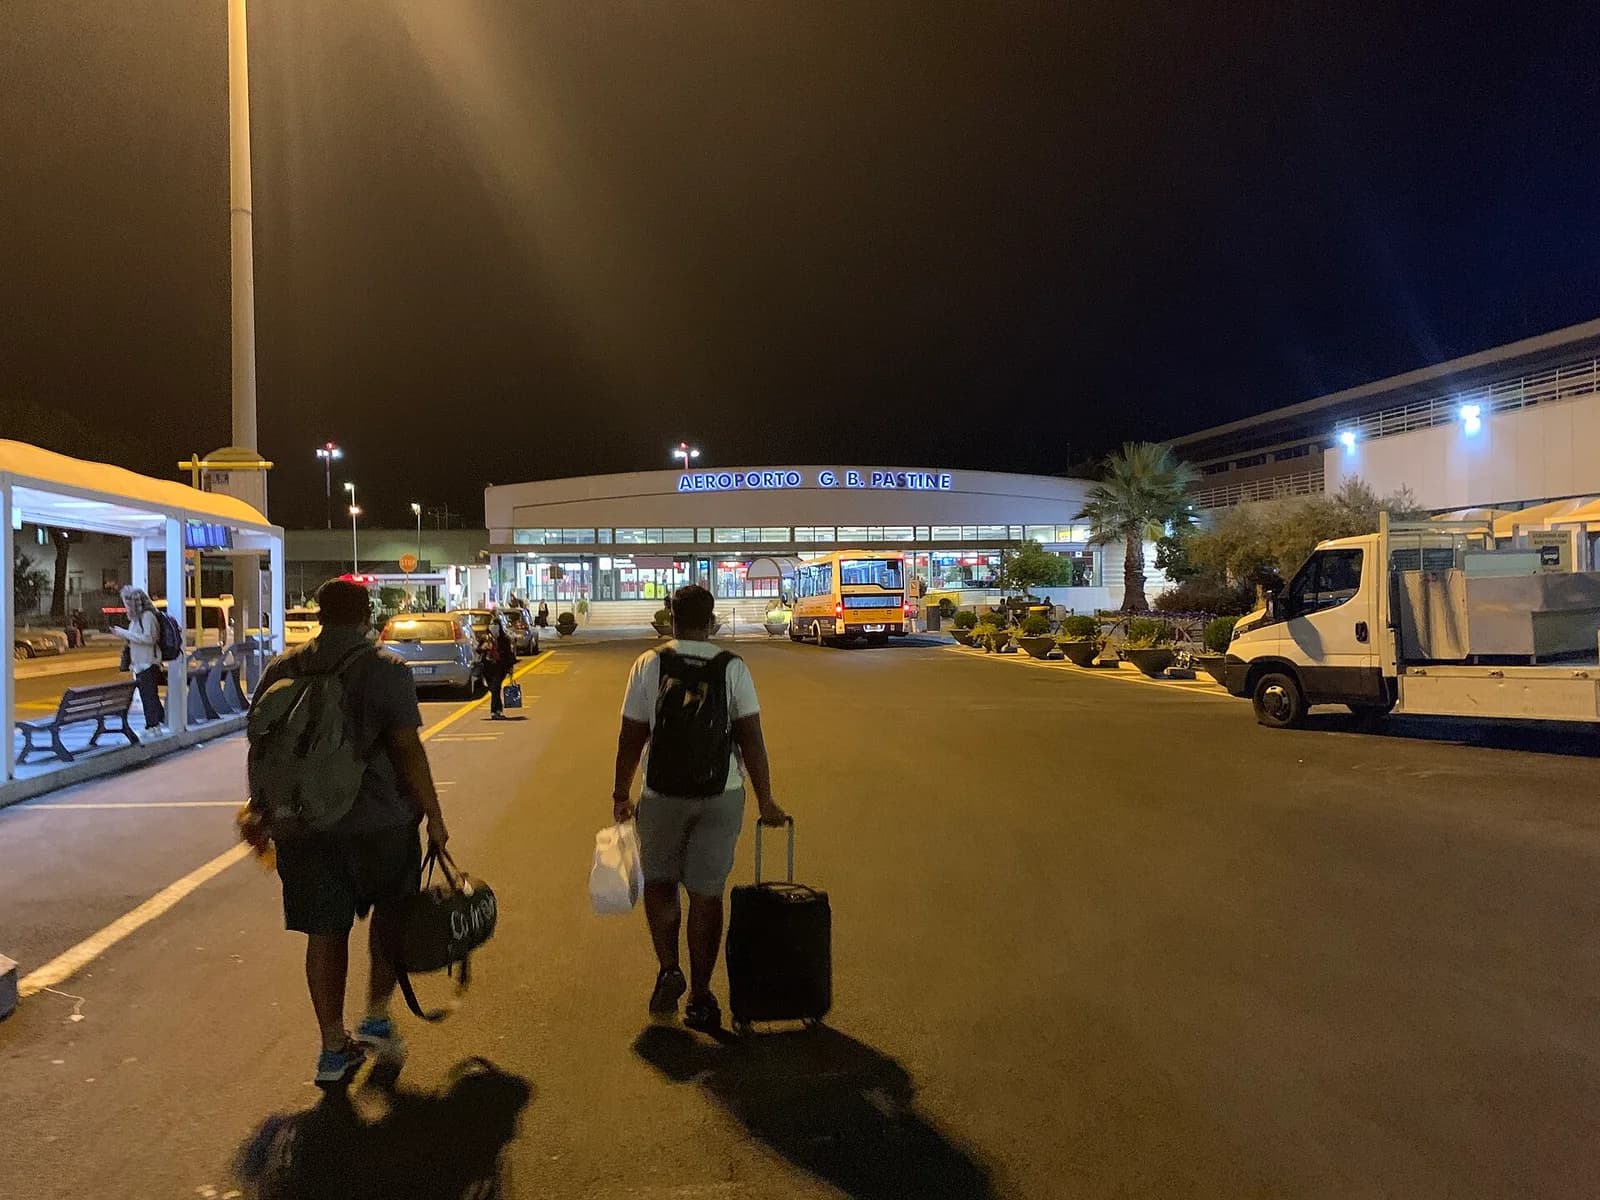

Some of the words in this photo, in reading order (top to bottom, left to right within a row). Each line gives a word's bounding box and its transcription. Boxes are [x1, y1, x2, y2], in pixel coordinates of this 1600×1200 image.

[679, 471, 801, 491] AEROPORTO
[819, 471, 839, 487] G.
[846, 471, 865, 487] B.
[871, 472, 951, 489] PASTINE
